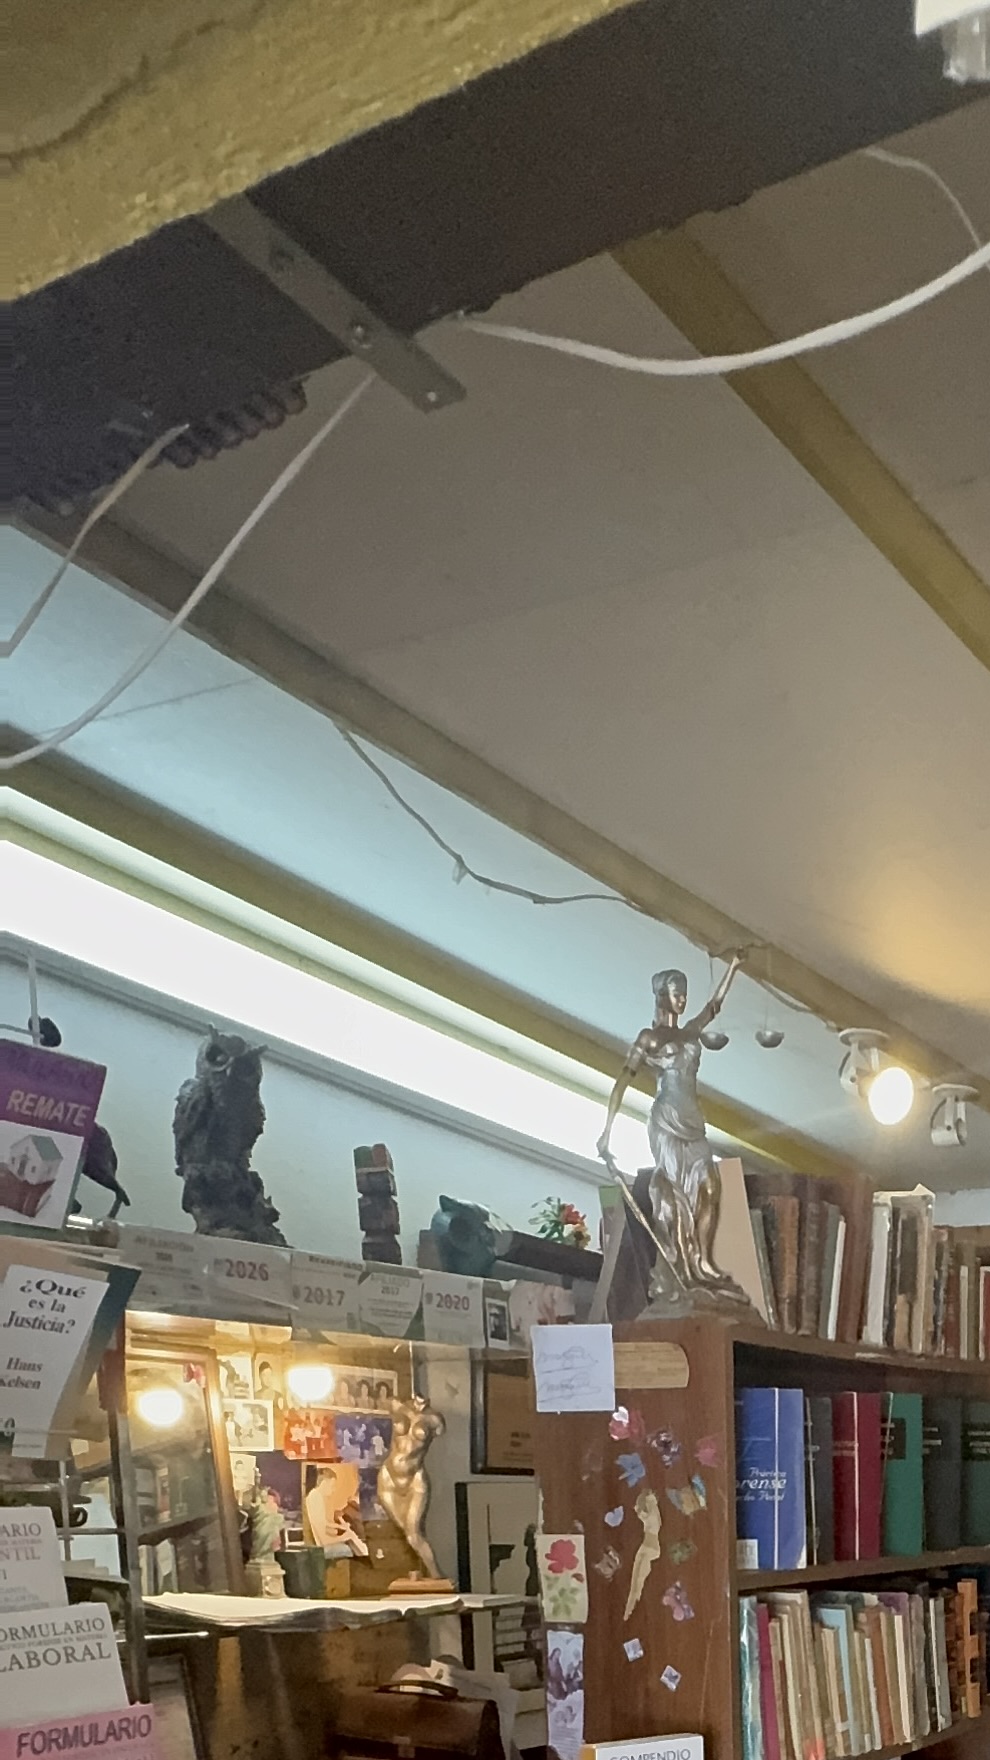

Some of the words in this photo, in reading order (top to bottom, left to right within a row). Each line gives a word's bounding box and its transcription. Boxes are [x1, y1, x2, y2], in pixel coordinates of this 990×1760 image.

[6, 1089, 92, 1127] REMATE
[19, 1277, 87, 1299] ¿Qué
[303, 1285, 346, 1307] 2017
[28, 1298, 45, 1311] es
[50, 1298, 67, 1313] la
[2, 1310, 76, 1335] Justicia?
[6, 1356, 44, 1373] Hans
[0, 1617, 106, 1642] ORMULARIO
[16, 1713, 153, 1758] FORMULARIO
